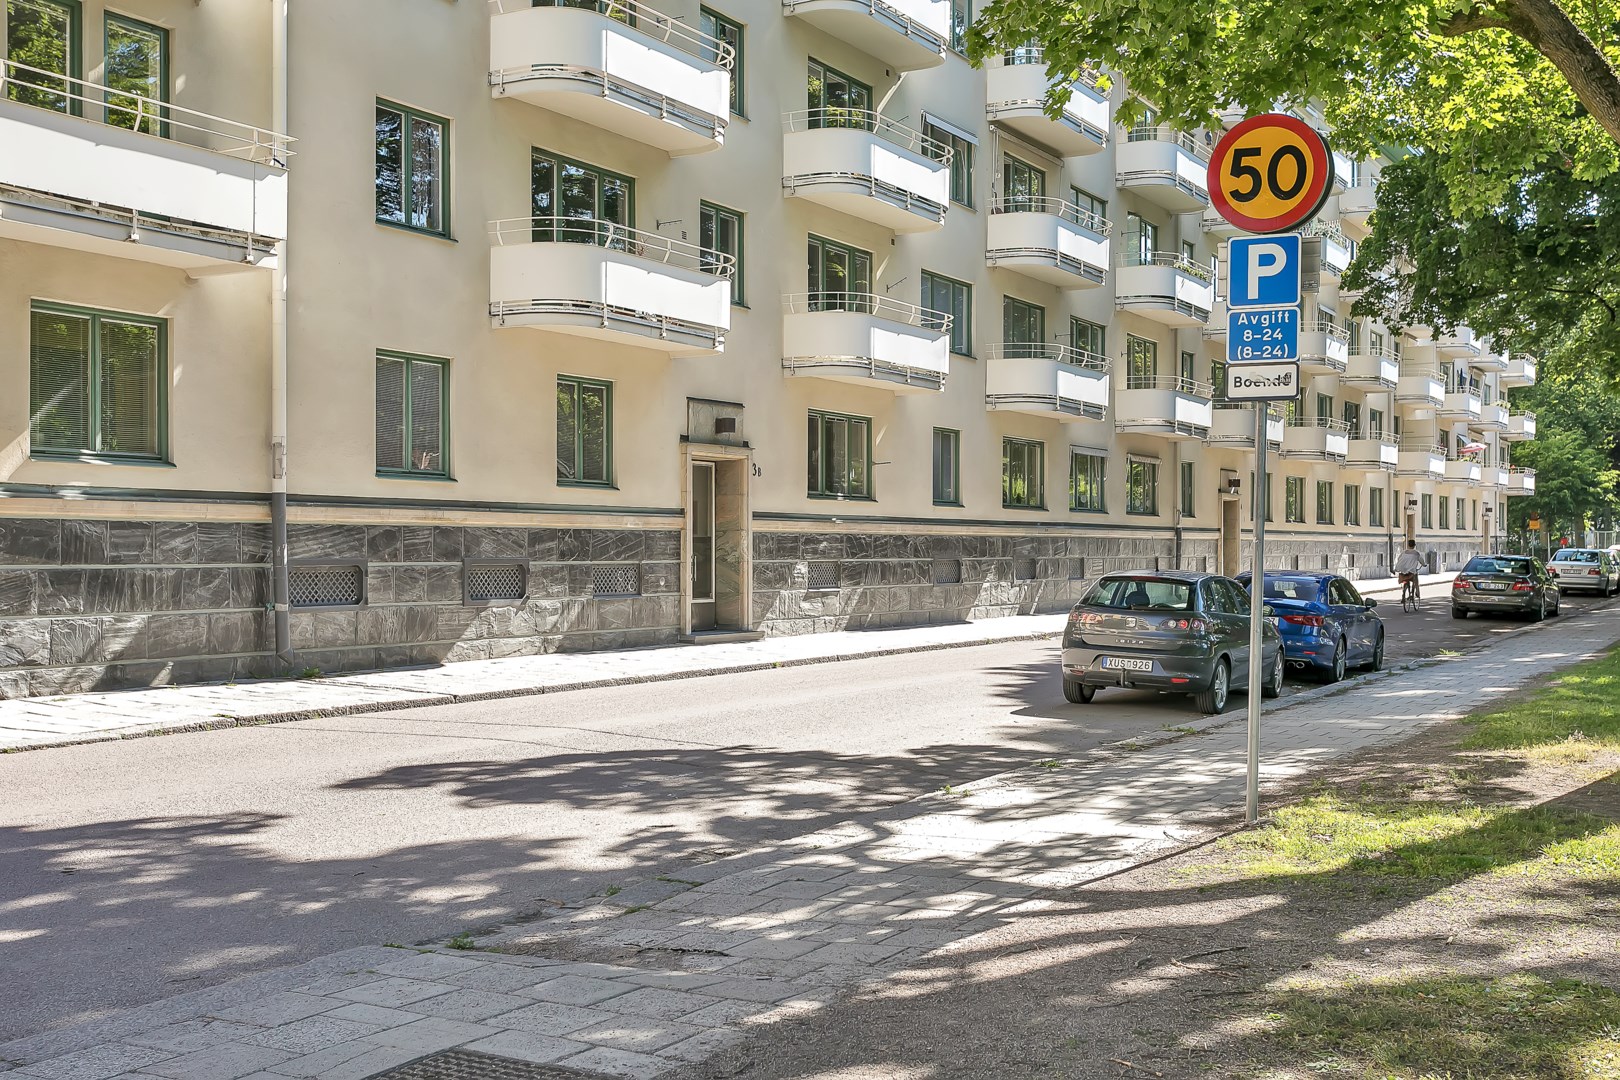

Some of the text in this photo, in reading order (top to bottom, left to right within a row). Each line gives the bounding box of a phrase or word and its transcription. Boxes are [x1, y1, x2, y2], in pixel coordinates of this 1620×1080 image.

[1228, 144, 1307, 203] 50
[1247, 243, 1287, 300] P
[1237, 311, 1290, 327] Avgift
[1243, 328, 1283, 342] 8-24
[1237, 343, 1289, 360] (8-24)
[1108, 658, 1150, 670] XUS 926
